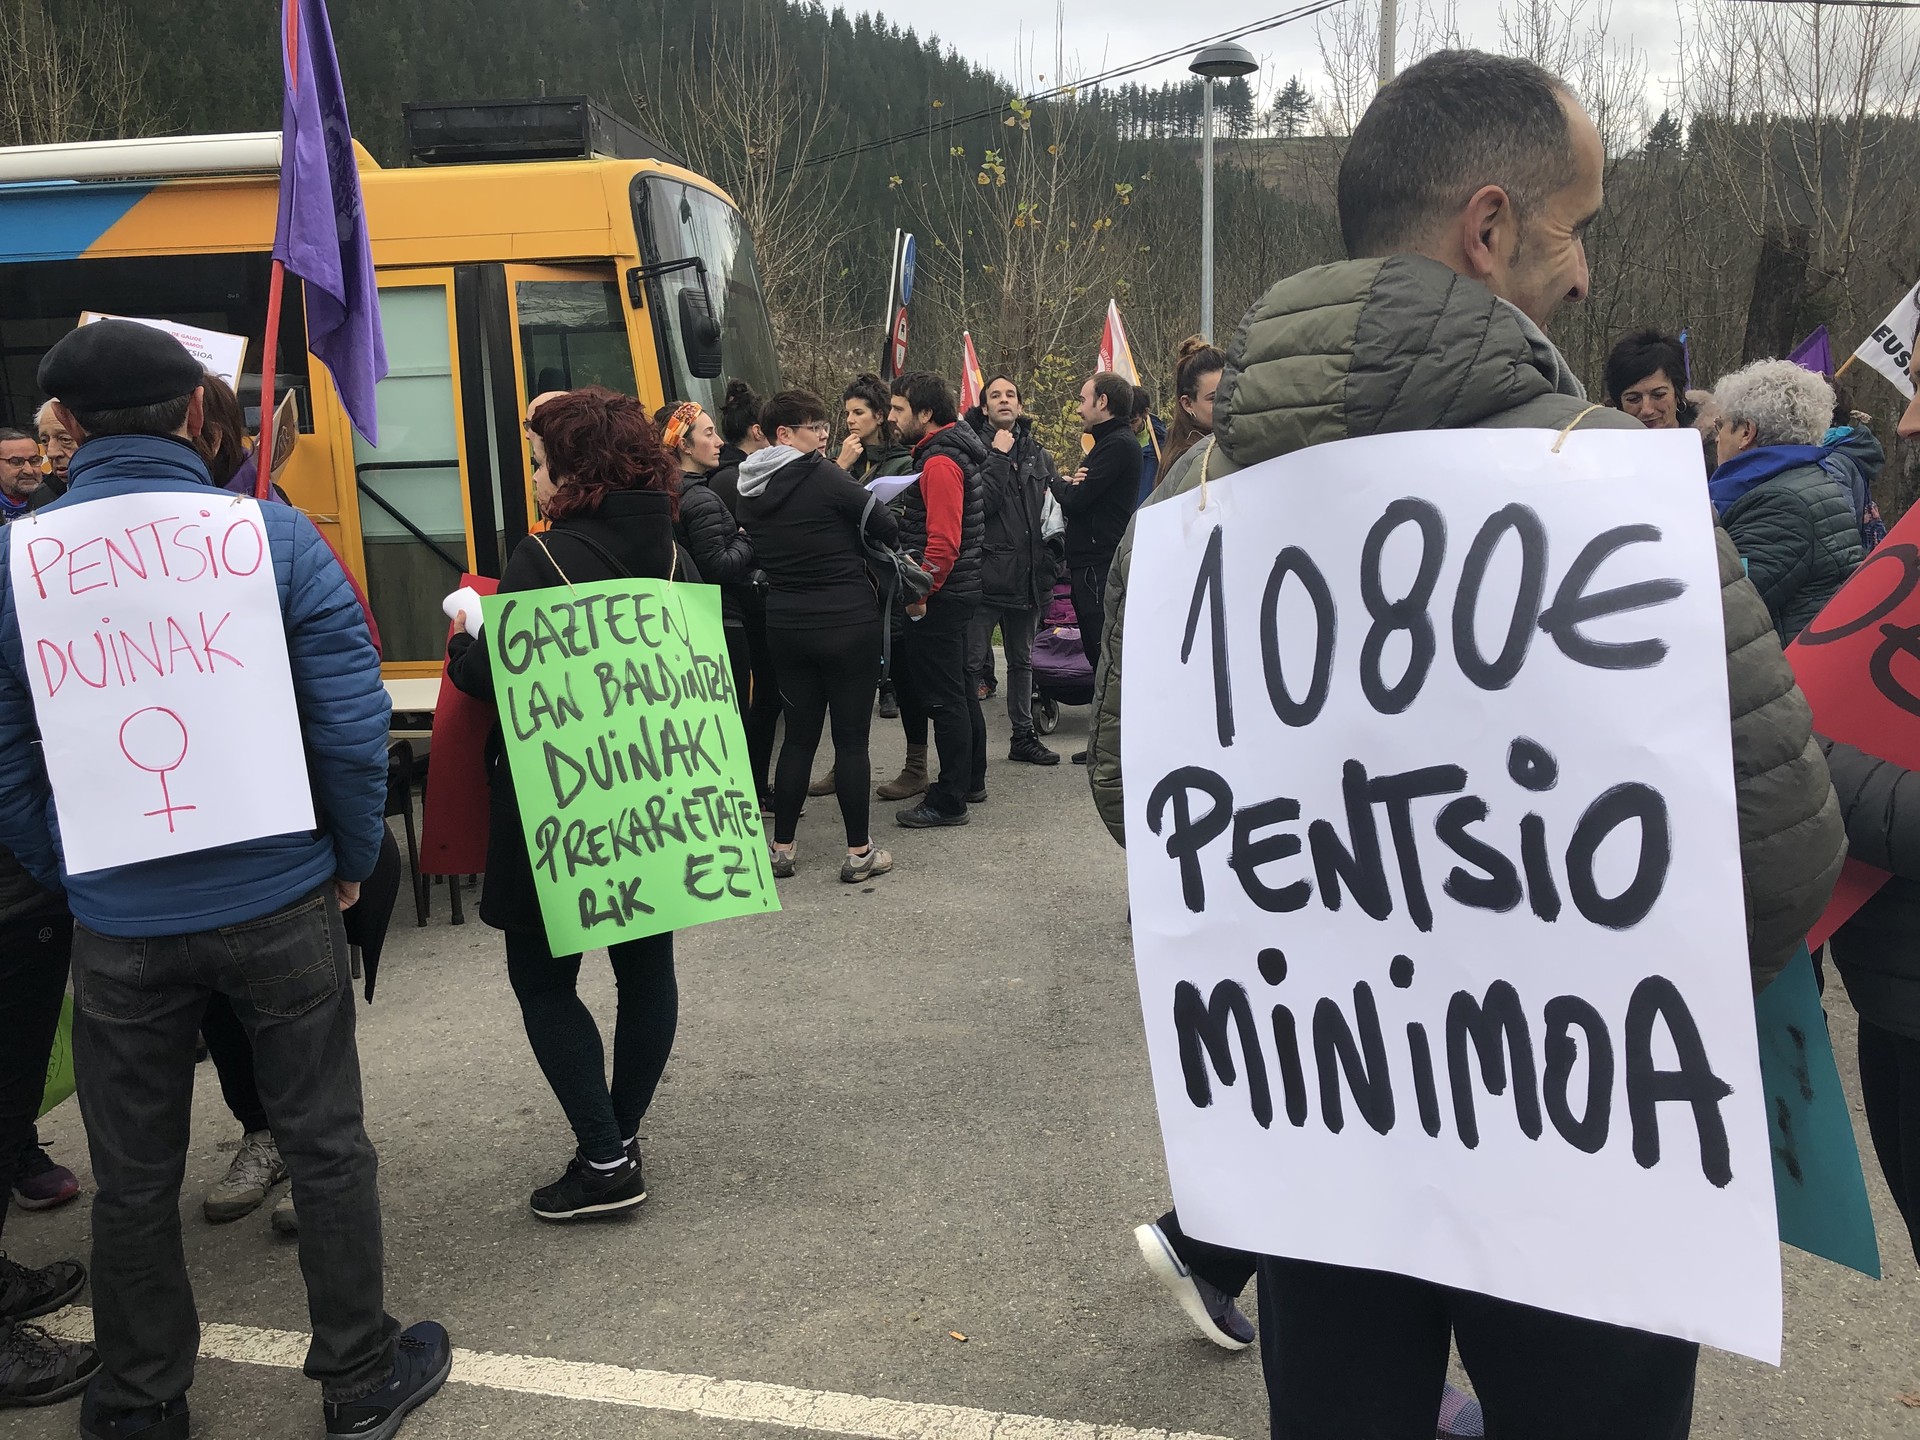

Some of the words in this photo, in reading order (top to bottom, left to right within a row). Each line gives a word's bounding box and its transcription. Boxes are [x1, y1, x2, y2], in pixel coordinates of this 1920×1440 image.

[180, 340, 204, 350] YAMOS
[497, 593, 690, 675] GAZTEEN
[1181, 496, 1691, 747] 1080€
[508, 671, 584, 741] LAN
[683, 845, 768, 907] EZ!
